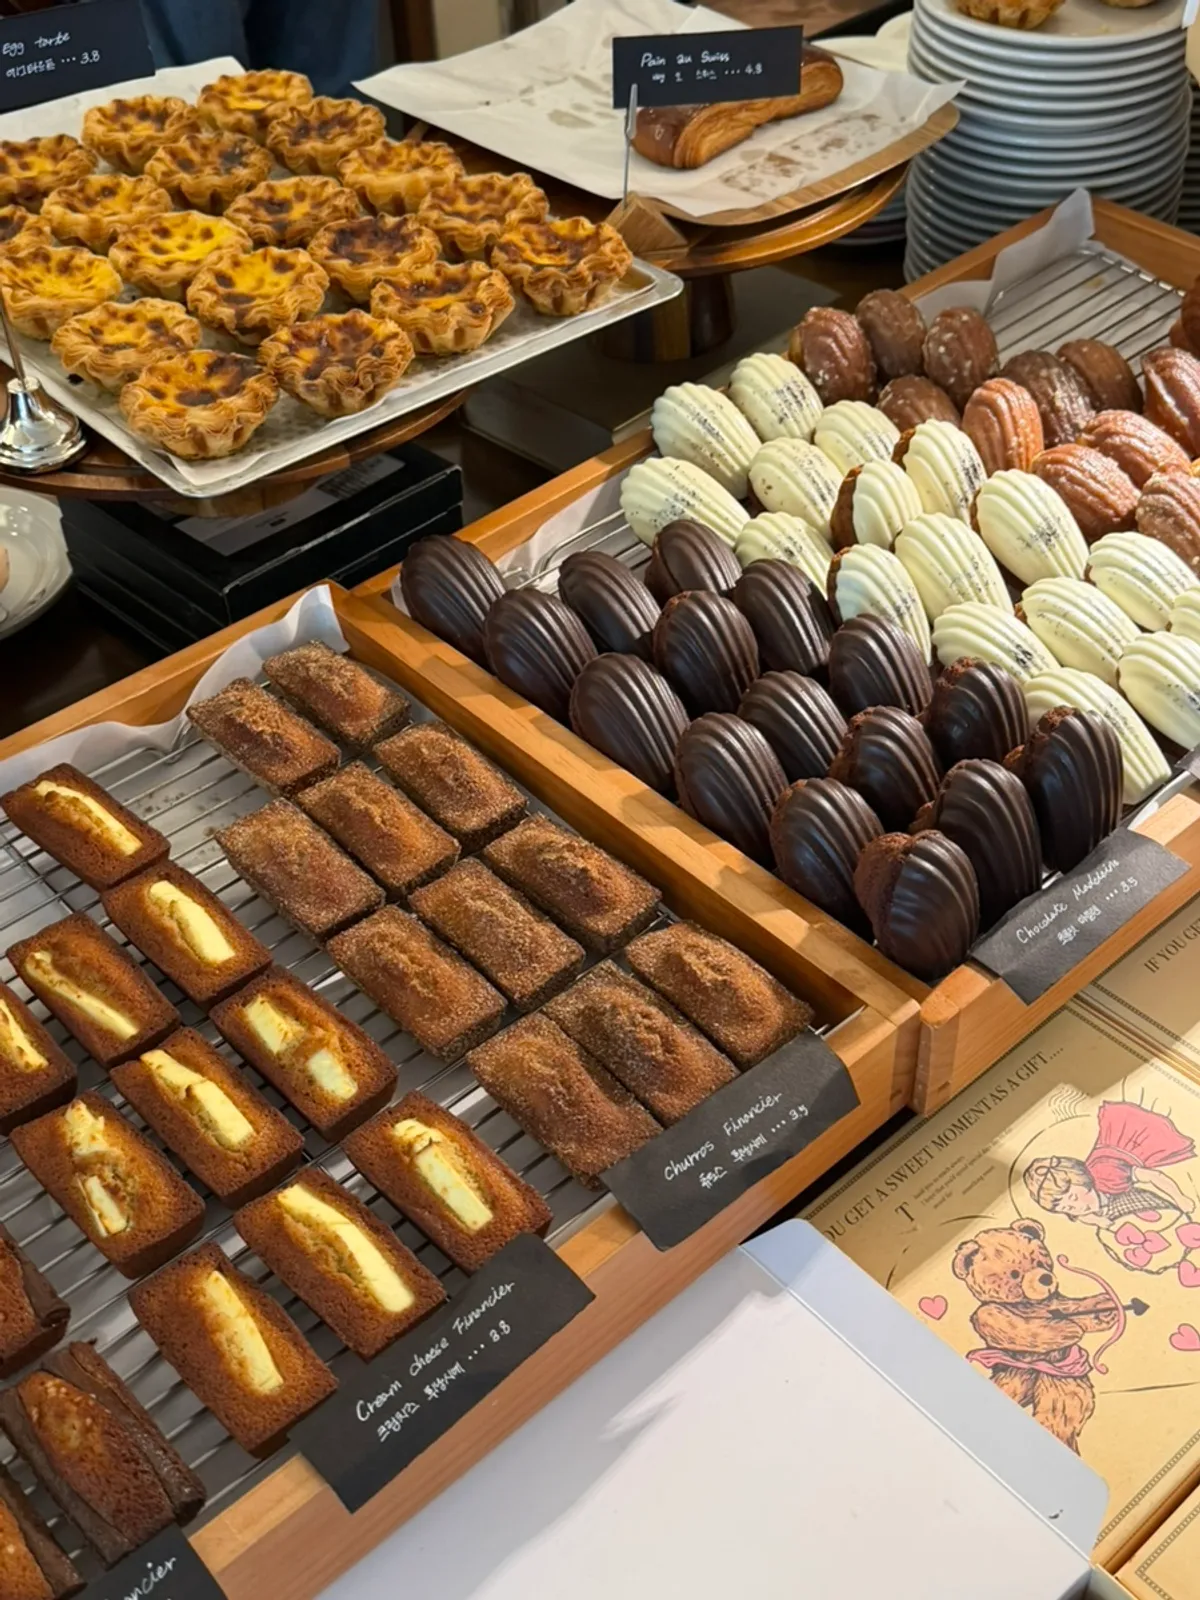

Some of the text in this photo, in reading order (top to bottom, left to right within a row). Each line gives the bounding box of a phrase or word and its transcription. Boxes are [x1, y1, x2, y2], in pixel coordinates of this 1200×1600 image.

[2, 42, 25, 57] Egg
[80, 50, 101, 65] 3.8
[640, 50, 730, 68] Pain au Swiss
[1016, 901, 1069, 944] Chocolate
[1156, 936, 1188, 962] YOU
[722, 1092, 783, 1137] Financier
[844, 1194, 877, 1226] GET
[876, 1187, 890, 1203] A
[884, 1145, 936, 1193] SWEET
[932, 1096, 994, 1154] MOMENT
[991, 1084, 1009, 1106] AS
[1006, 1078, 1021, 1095] A
[355, 1379, 402, 1422] Cream
[452, 1281, 516, 1335] Financier
